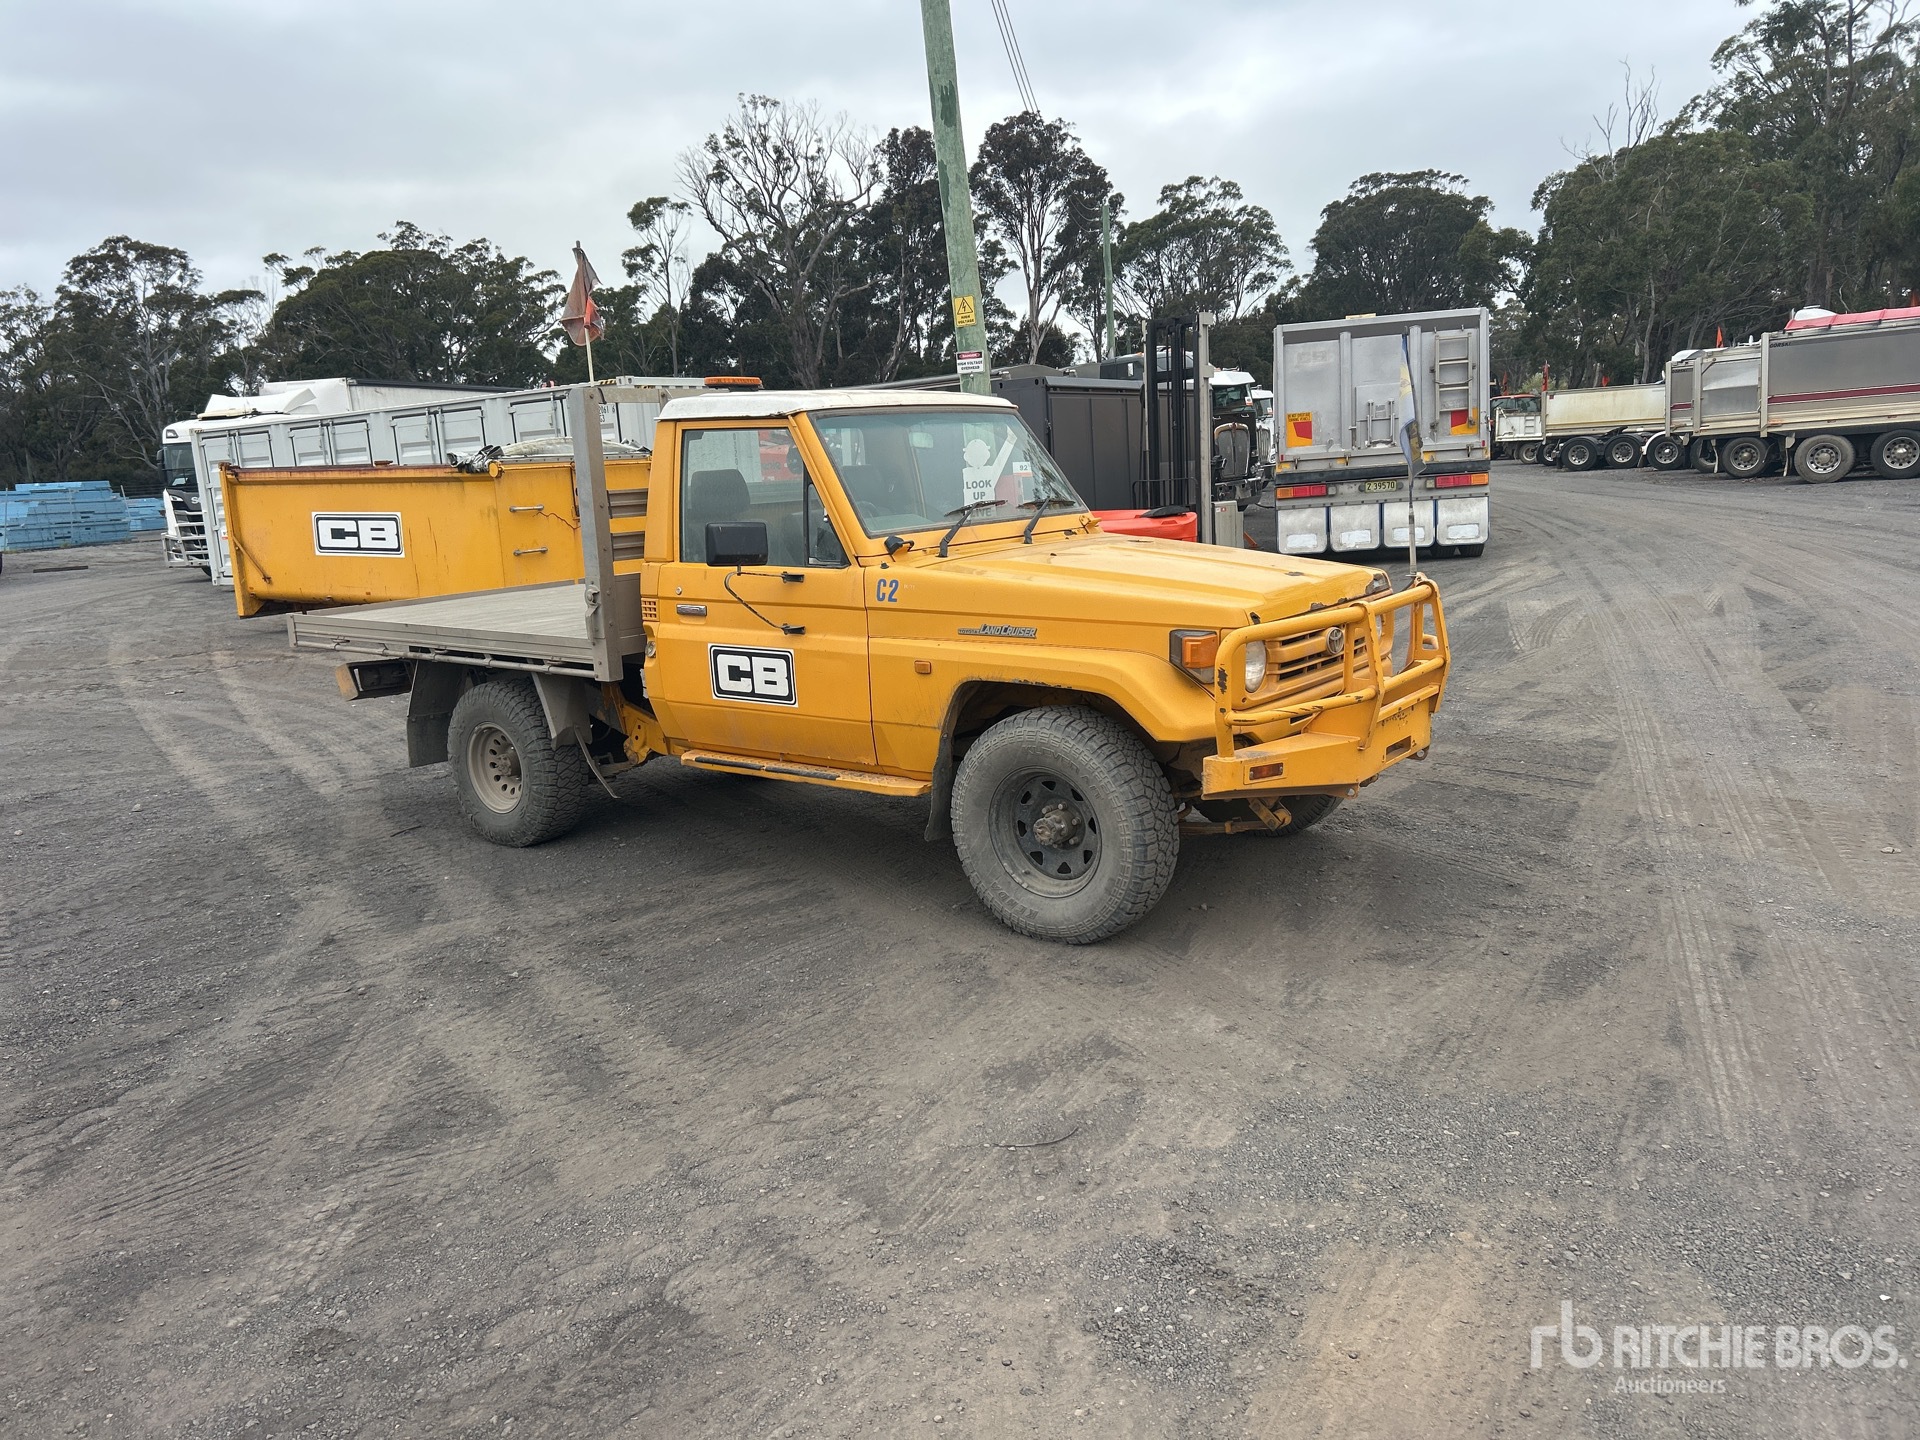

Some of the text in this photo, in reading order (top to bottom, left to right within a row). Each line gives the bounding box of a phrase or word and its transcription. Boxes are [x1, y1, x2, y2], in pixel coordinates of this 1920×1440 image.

[966, 480, 992, 489] LOOK
[973, 492, 986, 500] UP
[317, 519, 400, 549] CB
[876, 579, 899, 602] C2
[717, 654, 789, 697] CB
[990, 882, 1039, 920] KENDA
